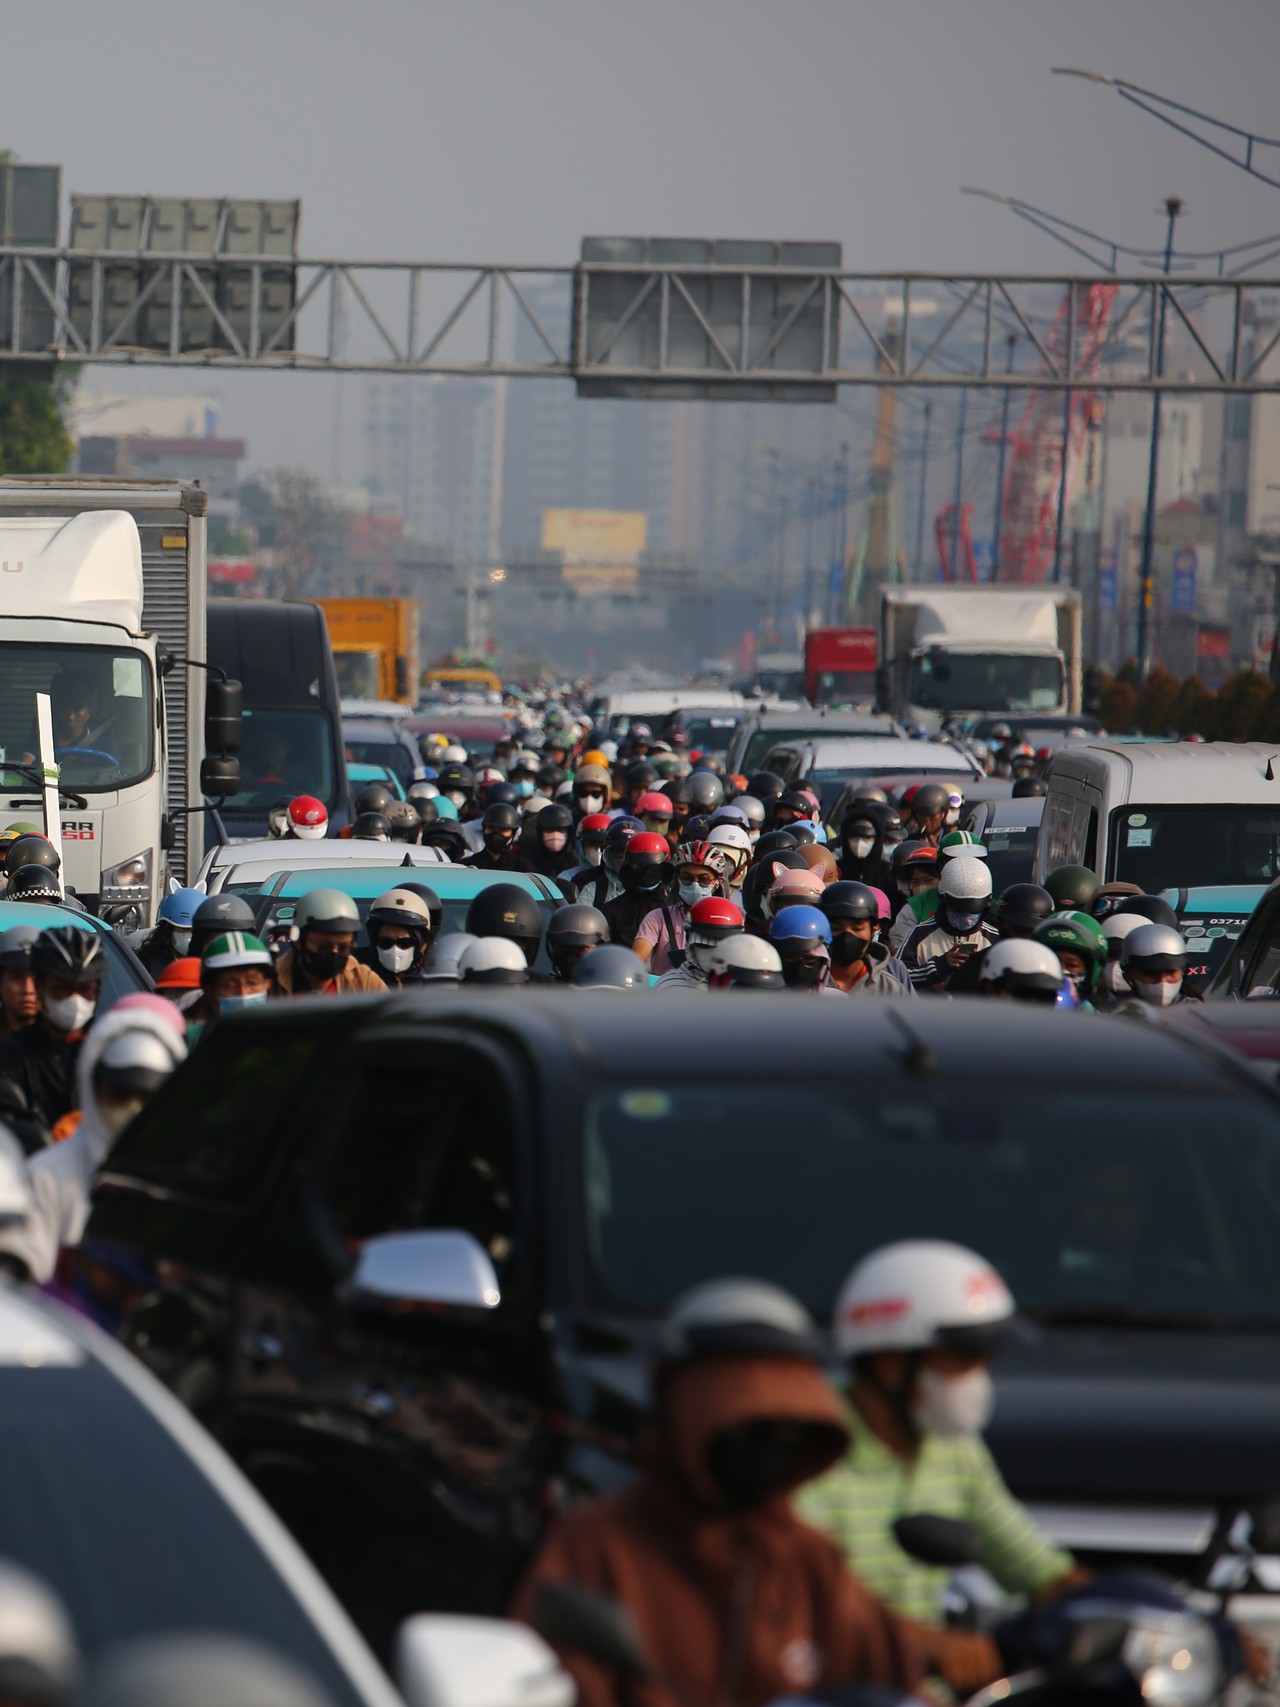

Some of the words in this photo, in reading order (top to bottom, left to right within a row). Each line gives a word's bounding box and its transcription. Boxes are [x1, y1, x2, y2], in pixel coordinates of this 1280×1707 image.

[61, 821, 93, 831] RR
[61, 831, 94, 840] 50
[1186, 965, 1208, 976] XI
